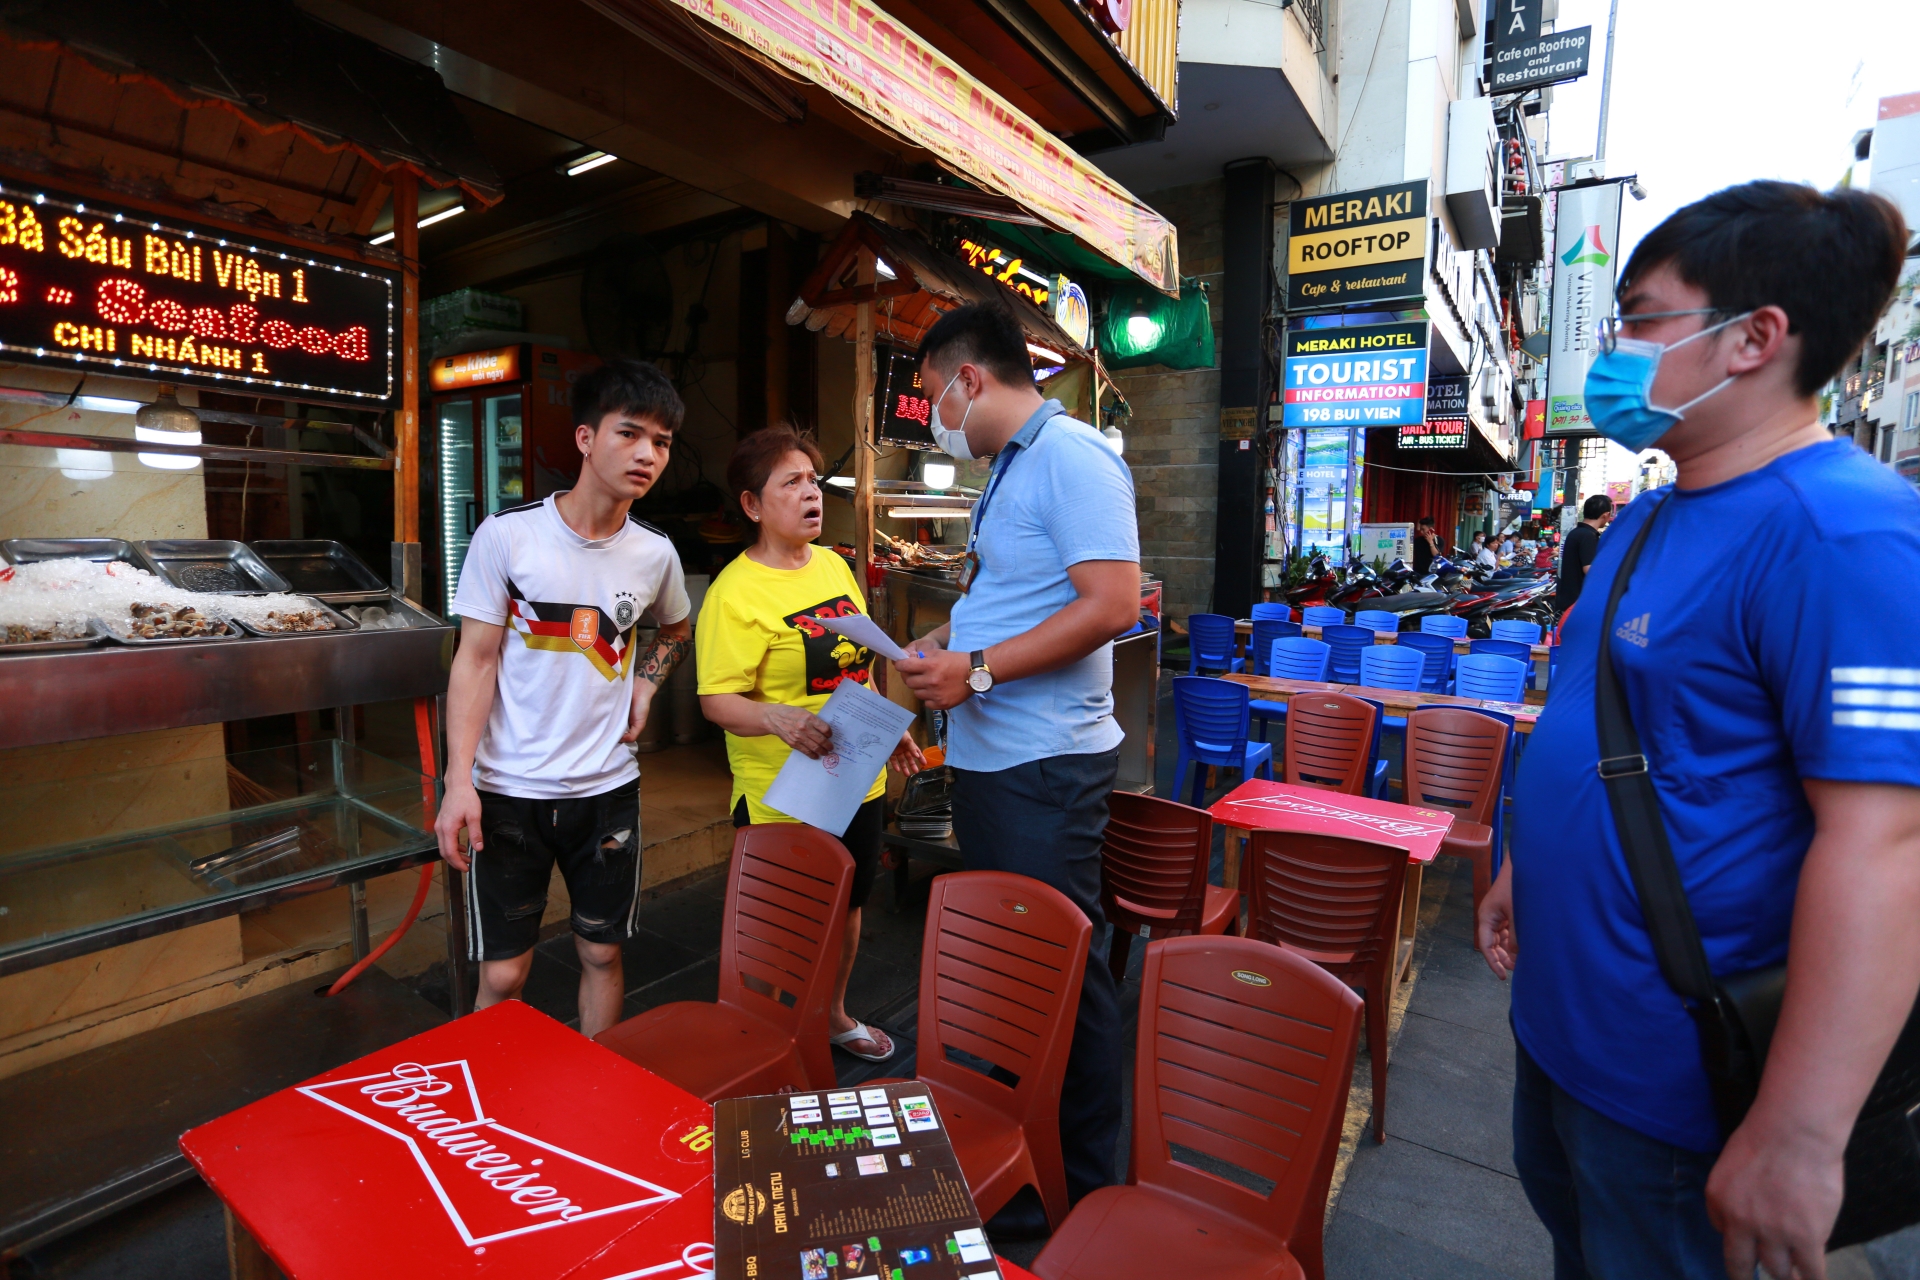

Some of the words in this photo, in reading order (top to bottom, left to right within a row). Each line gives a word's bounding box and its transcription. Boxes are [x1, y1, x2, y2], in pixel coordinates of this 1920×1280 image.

[720, 12, 743, 36] Bùi
[1508, 12, 1526, 35] A
[1497, 48, 1522, 63] Cafe
[1523, 45, 1538, 58] on
[1538, 35, 1586, 54] Rooftop
[1528, 54, 1550, 66] and
[1496, 57, 1582, 84] Restaurant
[814, 29, 865, 78] BBQ
[890, 82, 960, 138] Seafood
[972, 134, 1020, 176] Saigon
[1022, 164, 1056, 200] Night
[1304, 190, 1413, 230] MERAKI
[58, 215, 132, 270] Sáu
[144, 234, 202, 283] Bùi
[212, 249, 281, 303] Viện
[292, 268, 309, 303] 1
[1301, 230, 1411, 263] ROOFTOP
[1301, 282, 1327, 298] Cafe
[1330, 279, 1341, 293] &
[1345, 272, 1407, 291] restaurant
[98, 278, 370, 362] Seafood
[1577, 270, 1593, 352] VINAMA
[53, 321, 116, 353] CHI
[130, 335, 242, 371] NHÁNH
[251, 351, 270, 374] 1
[1296, 337, 1356, 353] MERAKI
[1360, 332, 1416, 349] HOTEL
[1293, 357, 1417, 386] TOURIST
[1295, 384, 1411, 402] INFORMATION
[1303, 407, 1331, 422] 198
[1333, 407, 1360, 421] BUI
[1363, 406, 1401, 420] VIEN
[1401, 436, 1415, 445] AIR
[1418, 435, 1434, 444] BUS
[1434, 434, 1462, 444] TICKET
[1402, 421, 1433, 435] DAILY
[1434, 420, 1464, 434] TOUR
[1307, 470, 1335, 478] HOTEL
[1616, 627, 1649, 649] adidas
[1258, 797, 1429, 838] Budweiser
[1236, 972, 1252, 980] SONG
[1252, 975, 1267, 984] LONG
[359, 1062, 584, 1223] Budweiser
[740, 1129, 750, 1147] CLUB
[741, 1148, 751, 1158] LG
[770, 1171, 784, 1200] MENU
[772, 1201, 788, 1233] DRINK
[746, 1255, 757, 1277] BBQ
